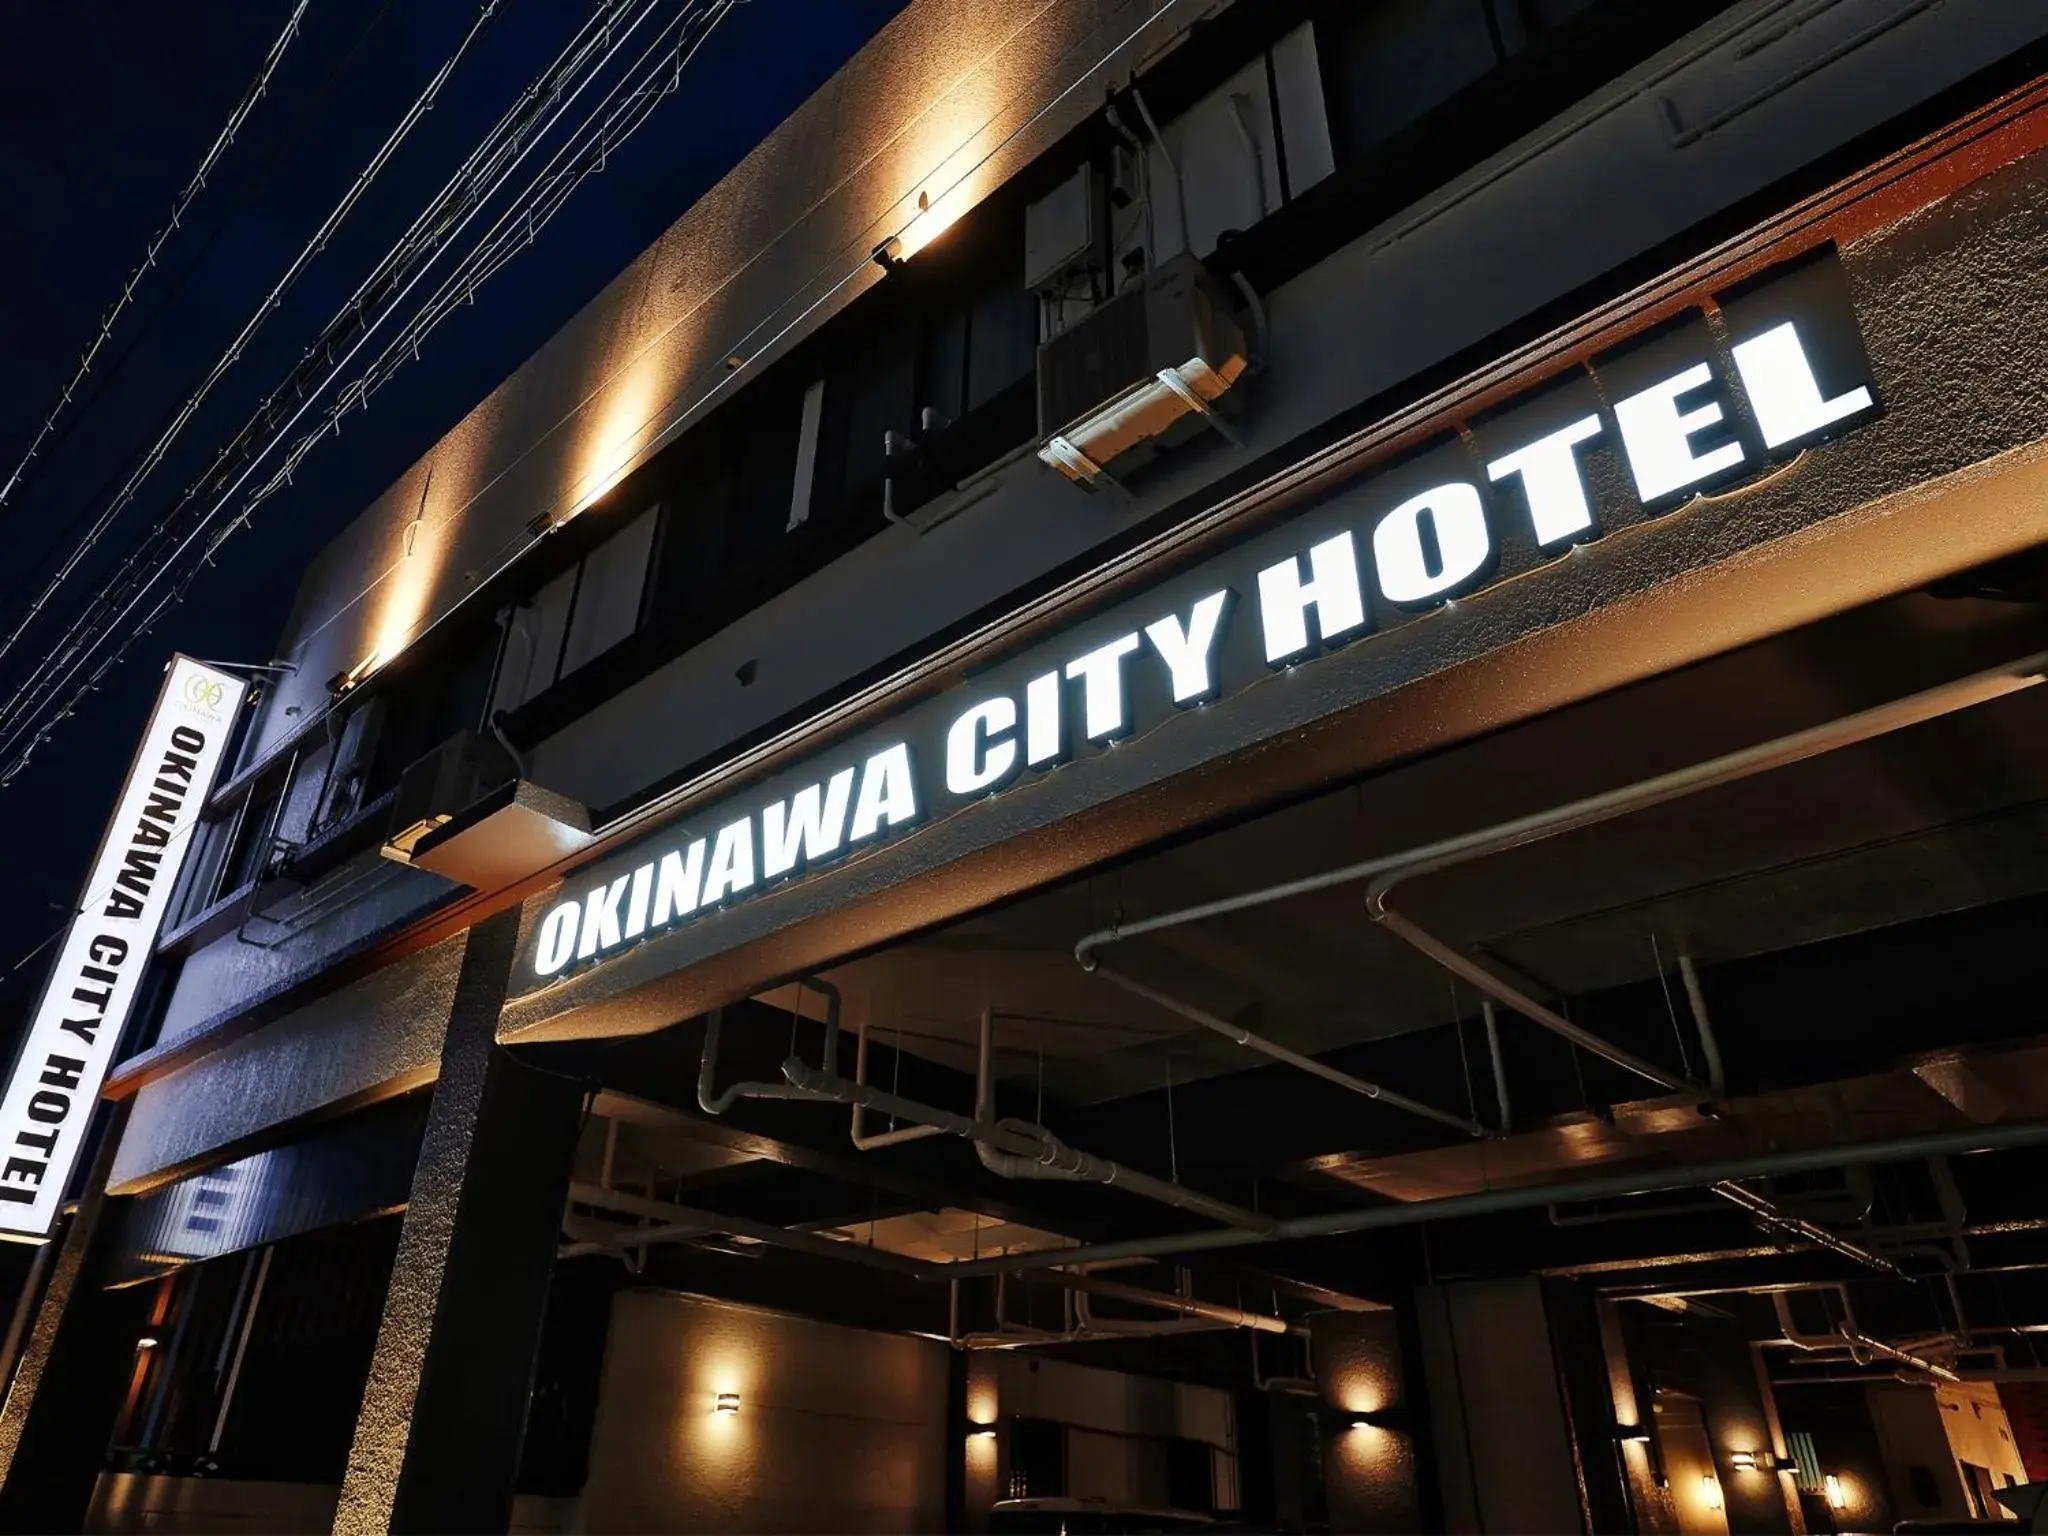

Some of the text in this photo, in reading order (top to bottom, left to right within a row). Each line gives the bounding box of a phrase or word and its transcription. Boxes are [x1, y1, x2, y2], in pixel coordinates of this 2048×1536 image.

[535, 321, 1874, 977] OKINAWA CITY HOTEL
[103, 725, 206, 920] OKINAWA
[60, 934, 129, 1045] CITY
